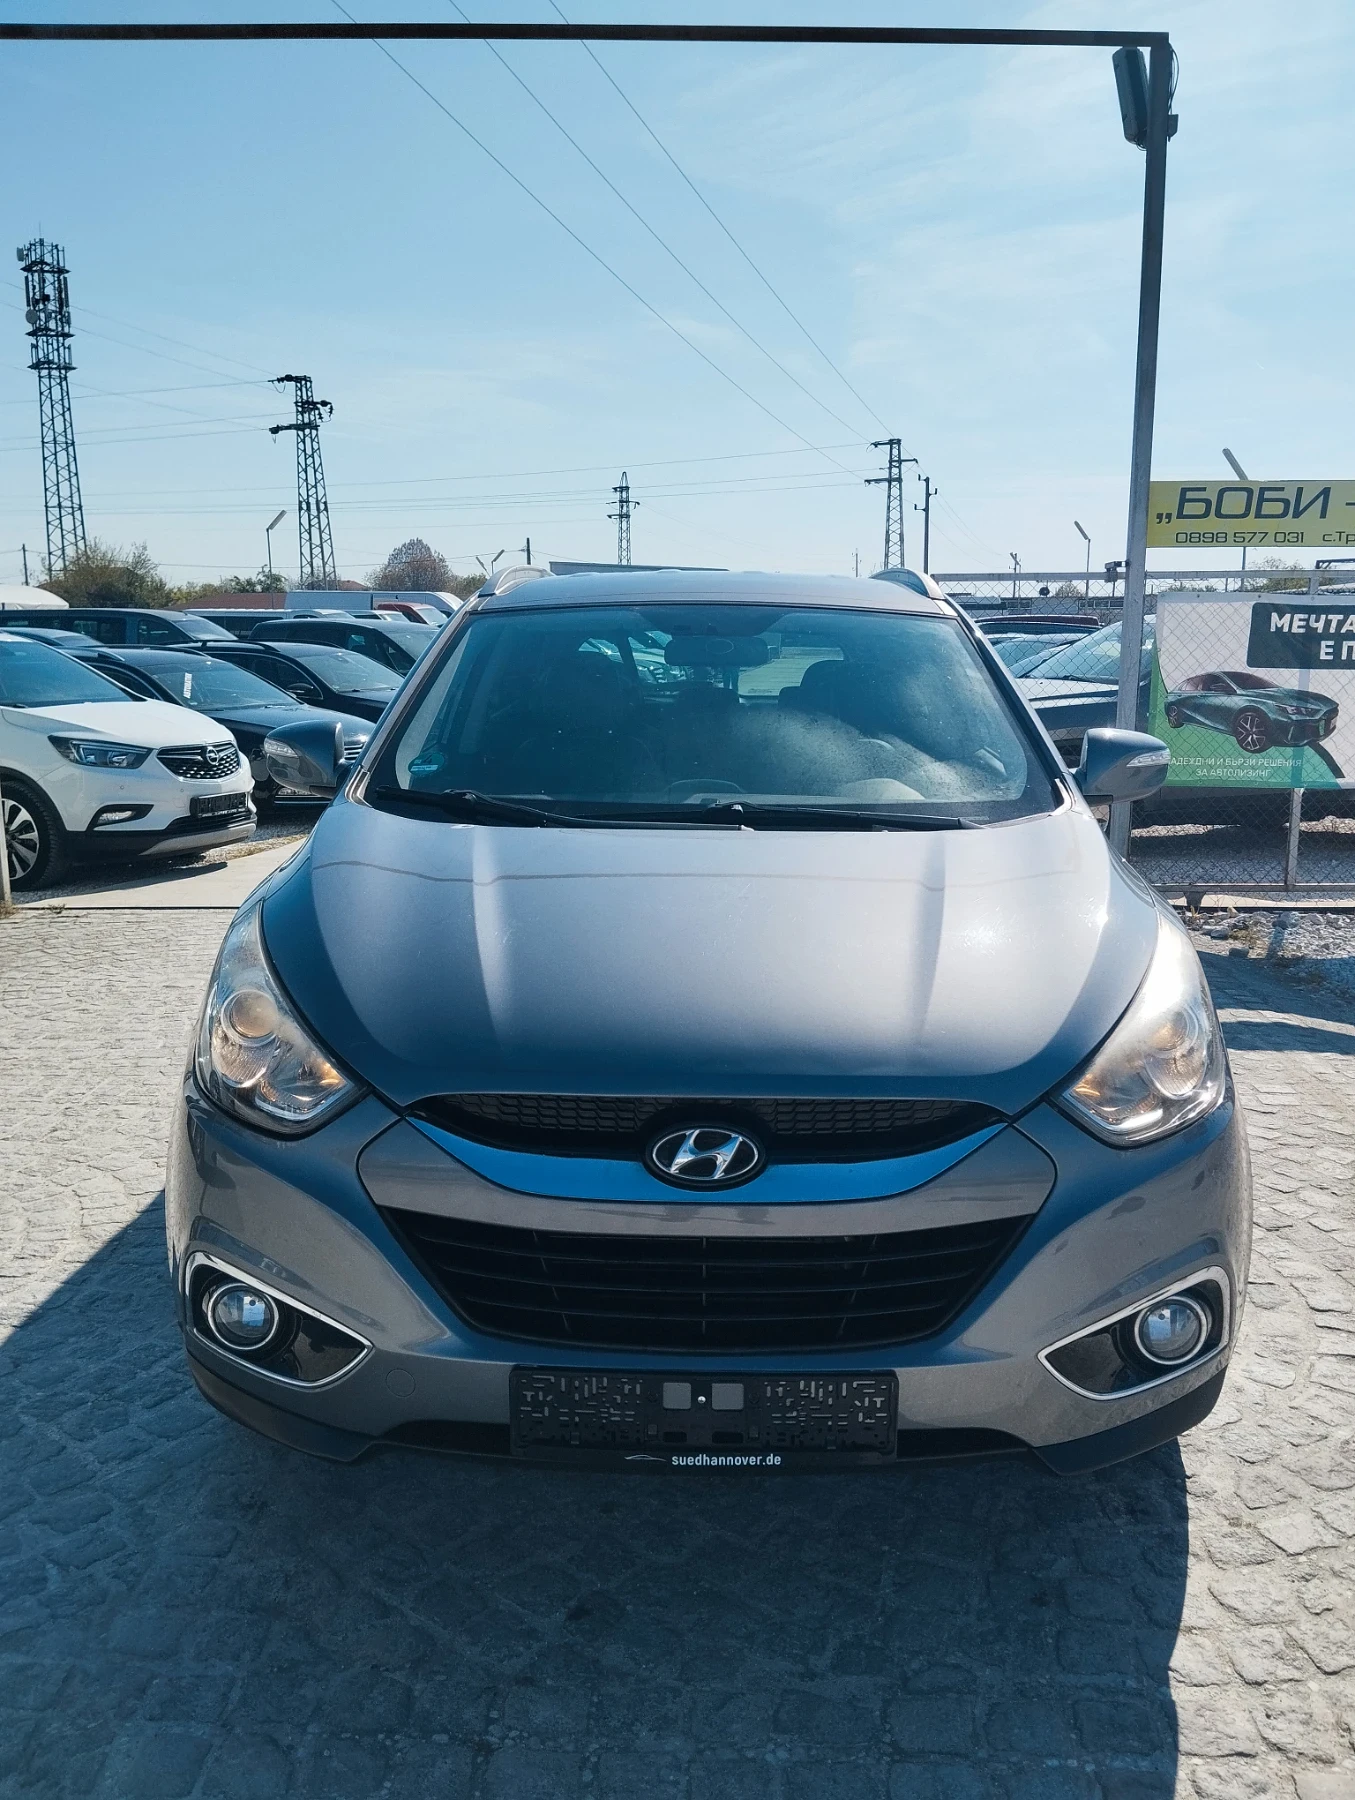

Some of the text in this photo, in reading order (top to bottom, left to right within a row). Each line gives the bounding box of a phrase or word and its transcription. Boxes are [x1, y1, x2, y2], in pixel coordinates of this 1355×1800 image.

[1175, 531, 1228, 544] 0898
[1233, 531, 1269, 544] 577
[1273, 531, 1304, 544] 031
[1270, 612, 1355, 634] МЕЧТА
[1320, 640, 1335, 660] Е
[1168, 757, 1215, 766] АДЕЖДНИ
[1217, 757, 1223, 766] И
[1257, 758, 1302, 767] РЕШЕНИЯ
[1195, 768, 1272, 777] ЗА АВТОЛИЗИНГ
[671, 1453, 782, 1466] suedhannover.de
